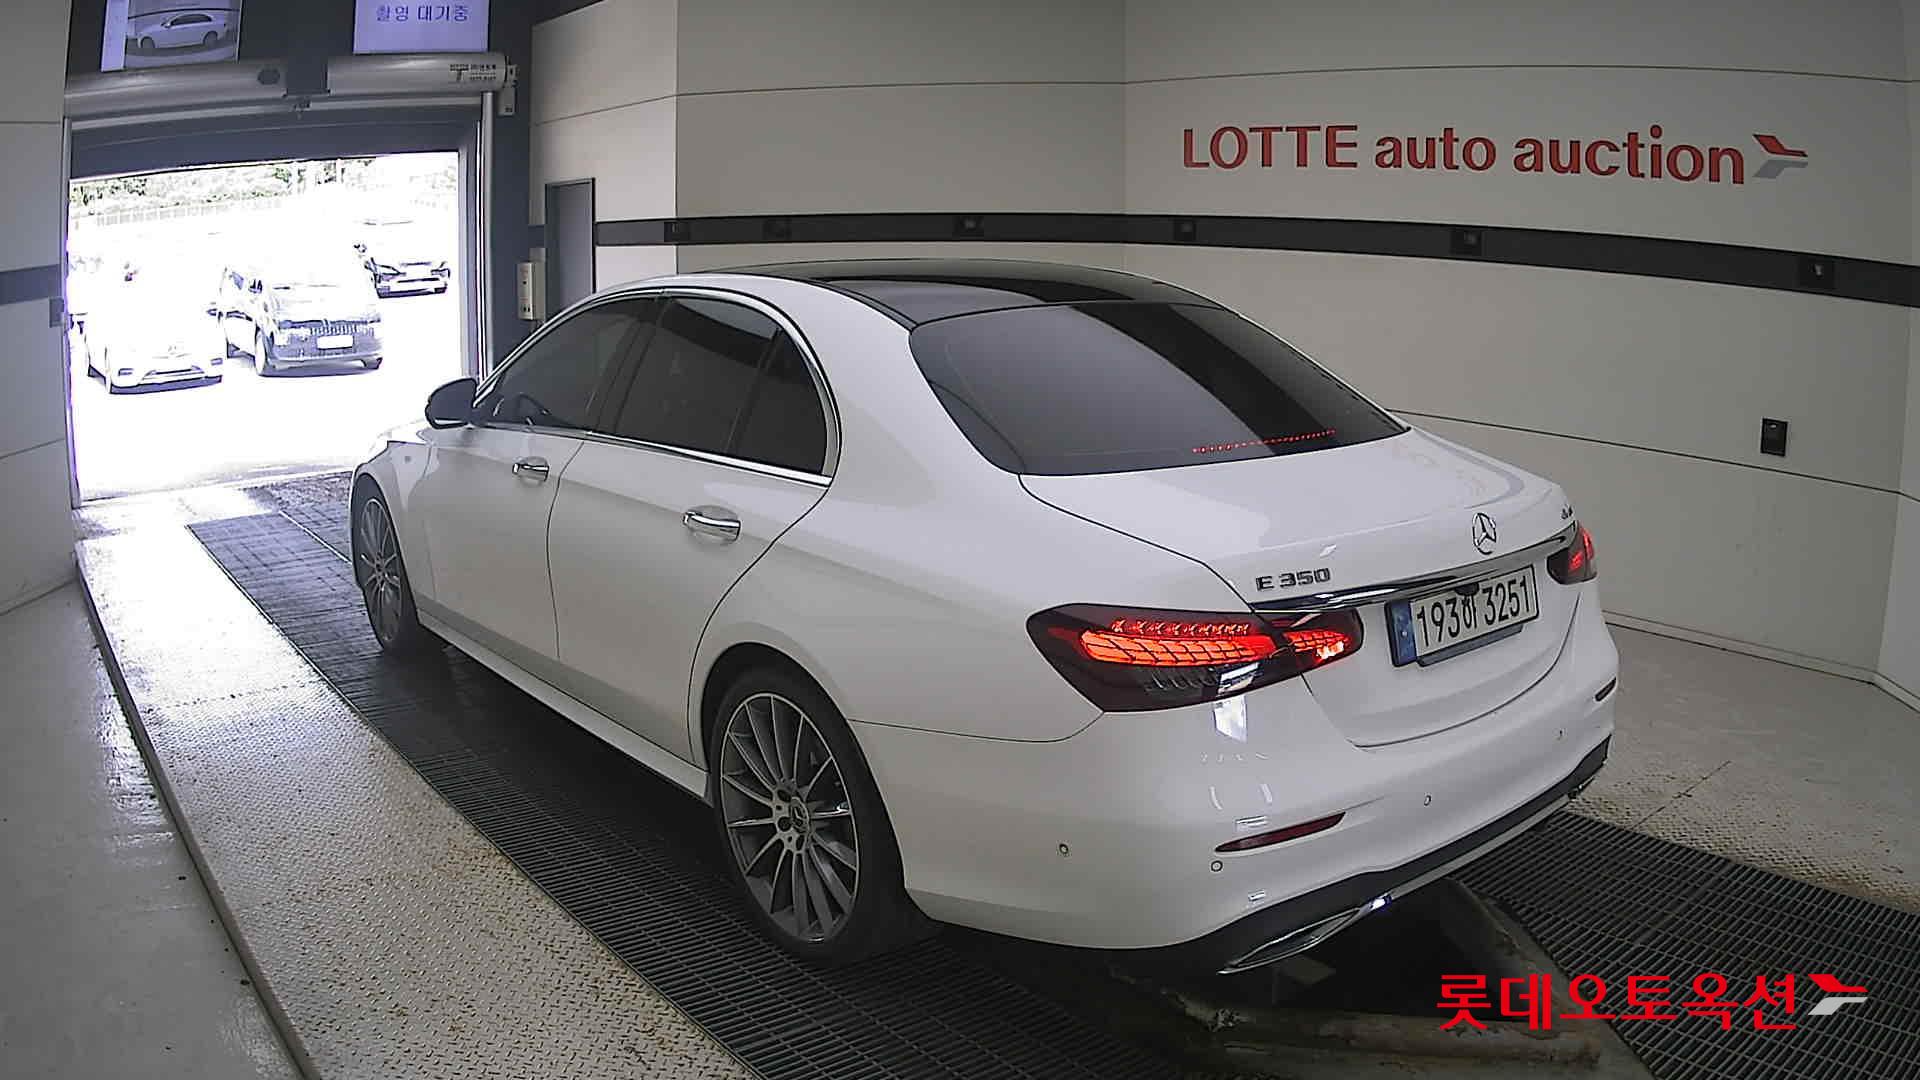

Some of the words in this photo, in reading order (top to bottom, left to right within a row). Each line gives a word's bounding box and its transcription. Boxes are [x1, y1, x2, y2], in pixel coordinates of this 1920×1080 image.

[417, 5, 469, 21] 대기중
[1183, 125, 1358, 169] LOTTE
[1375, 127, 1497, 171] auto
[1513, 126, 1745, 184] auction
[1256, 575, 1275, 591] E
[1279, 568, 1331, 588] 350
[1481, 575, 1530, 626] 3251
